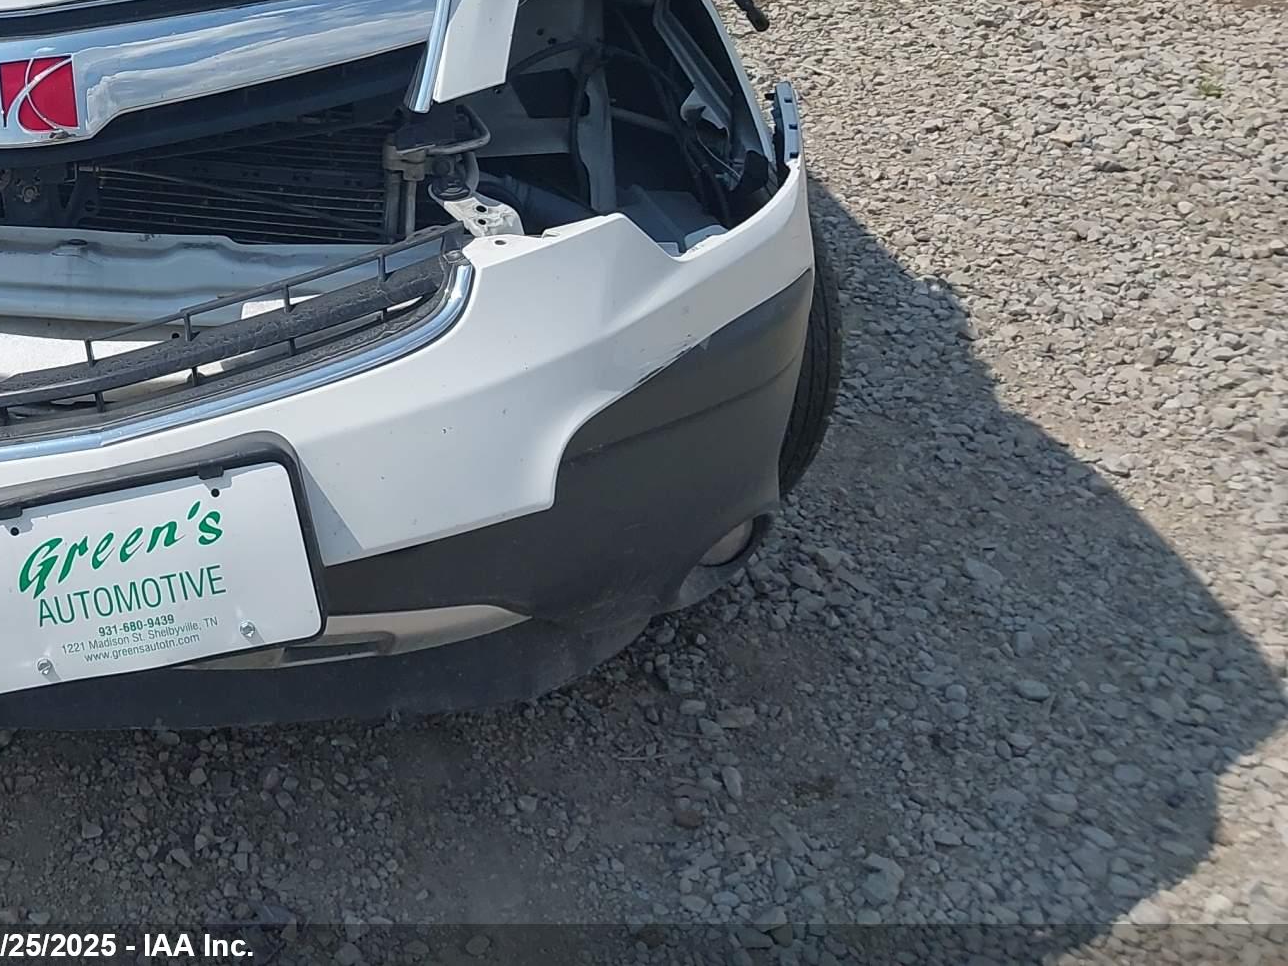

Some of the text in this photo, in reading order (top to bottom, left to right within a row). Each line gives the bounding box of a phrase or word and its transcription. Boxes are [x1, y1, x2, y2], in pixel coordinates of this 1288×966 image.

[19, 500, 223, 599] Green's
[39, 564, 226, 627] AUTOMOTIVE
[61, 616, 219, 655] 1221 Madison St. Shelbyville, TN
[98, 614, 175, 637] 931-680-9439
[84, 634, 200, 663] www.greensautotn.com
